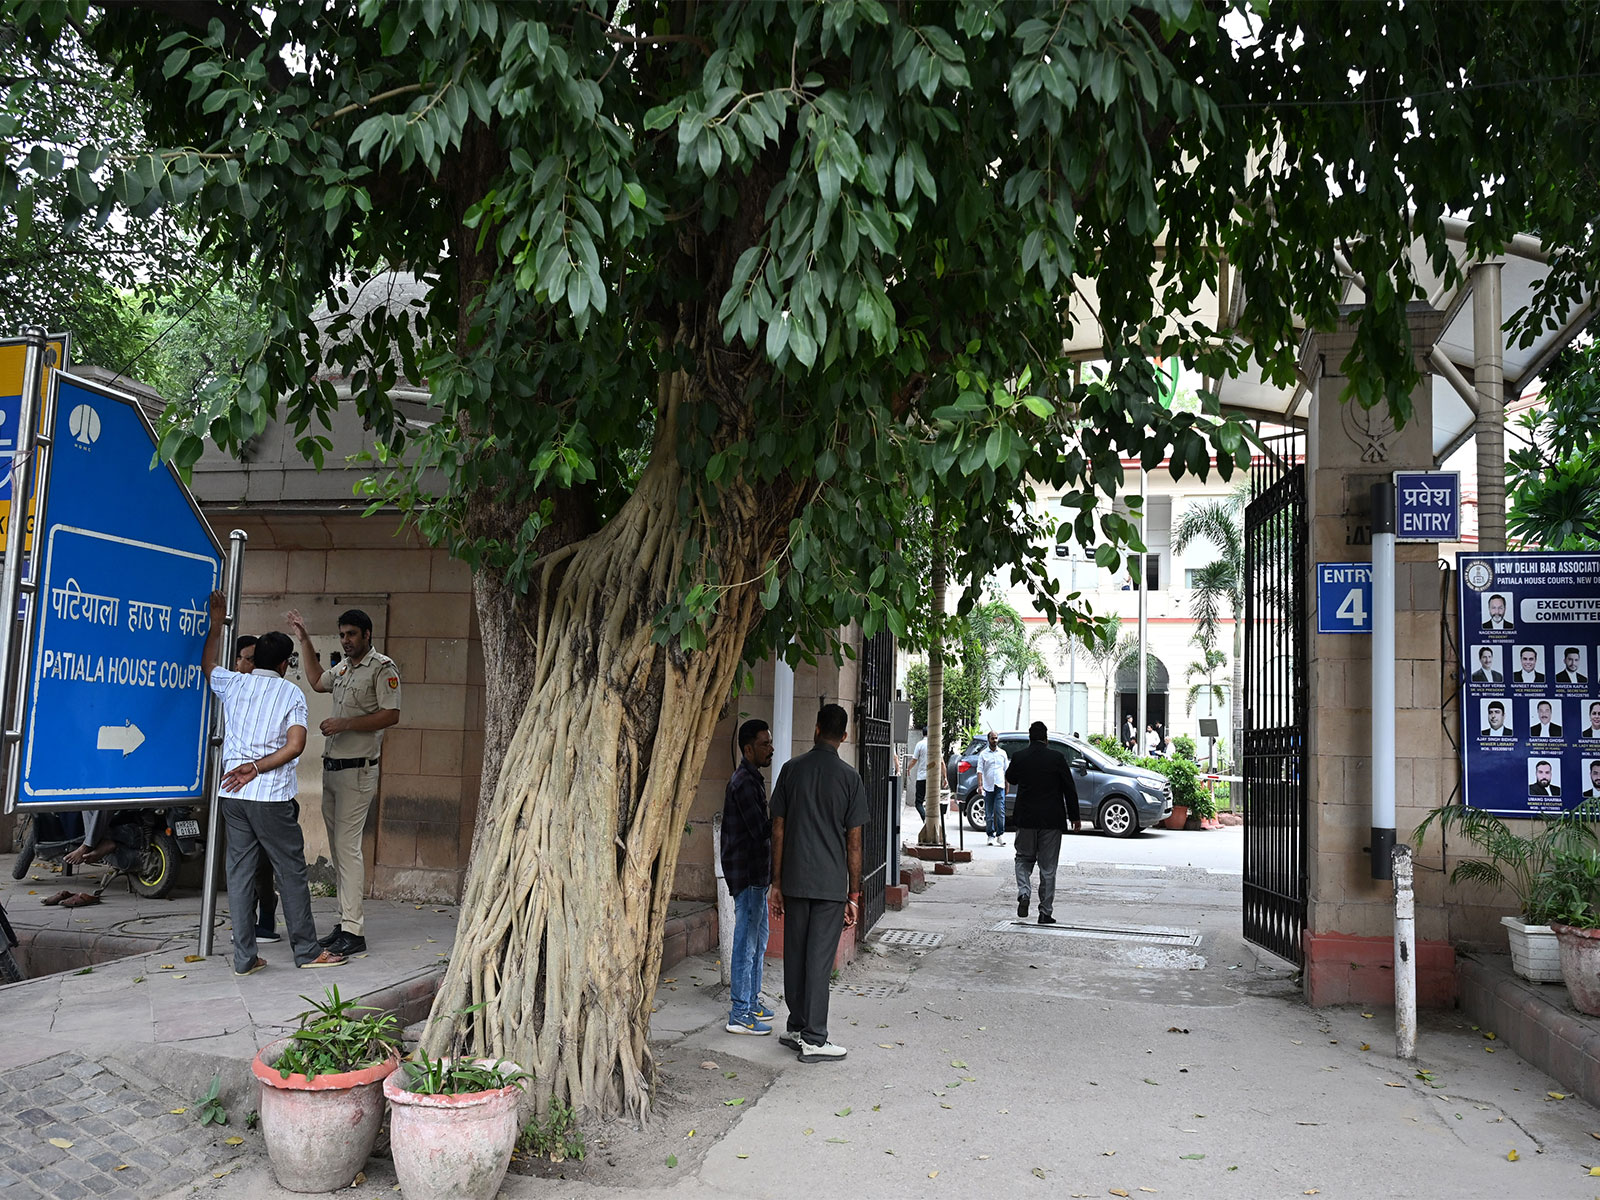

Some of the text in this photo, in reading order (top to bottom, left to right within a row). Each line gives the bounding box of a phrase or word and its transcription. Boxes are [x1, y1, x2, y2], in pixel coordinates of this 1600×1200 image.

[1403, 481, 1451, 506] प्रवेश
[1403, 513, 1451, 531] ENTRY
[1324, 569, 1372, 583] ENTRY
[1494, 562, 1513, 574] NEW
[1515, 562, 1538, 574] DELHI
[1540, 562, 1556, 573] BAR
[1547, 577, 1575, 585] COURTS,
[1576, 576, 1592, 584] NEW
[52, 577, 120, 627] पटियाला
[179, 598, 208, 637] कोर्ट
[1336, 588, 1368, 626] 4
[43, 650, 104, 683] PATIALA
[108, 657, 157, 687] HOUSE
